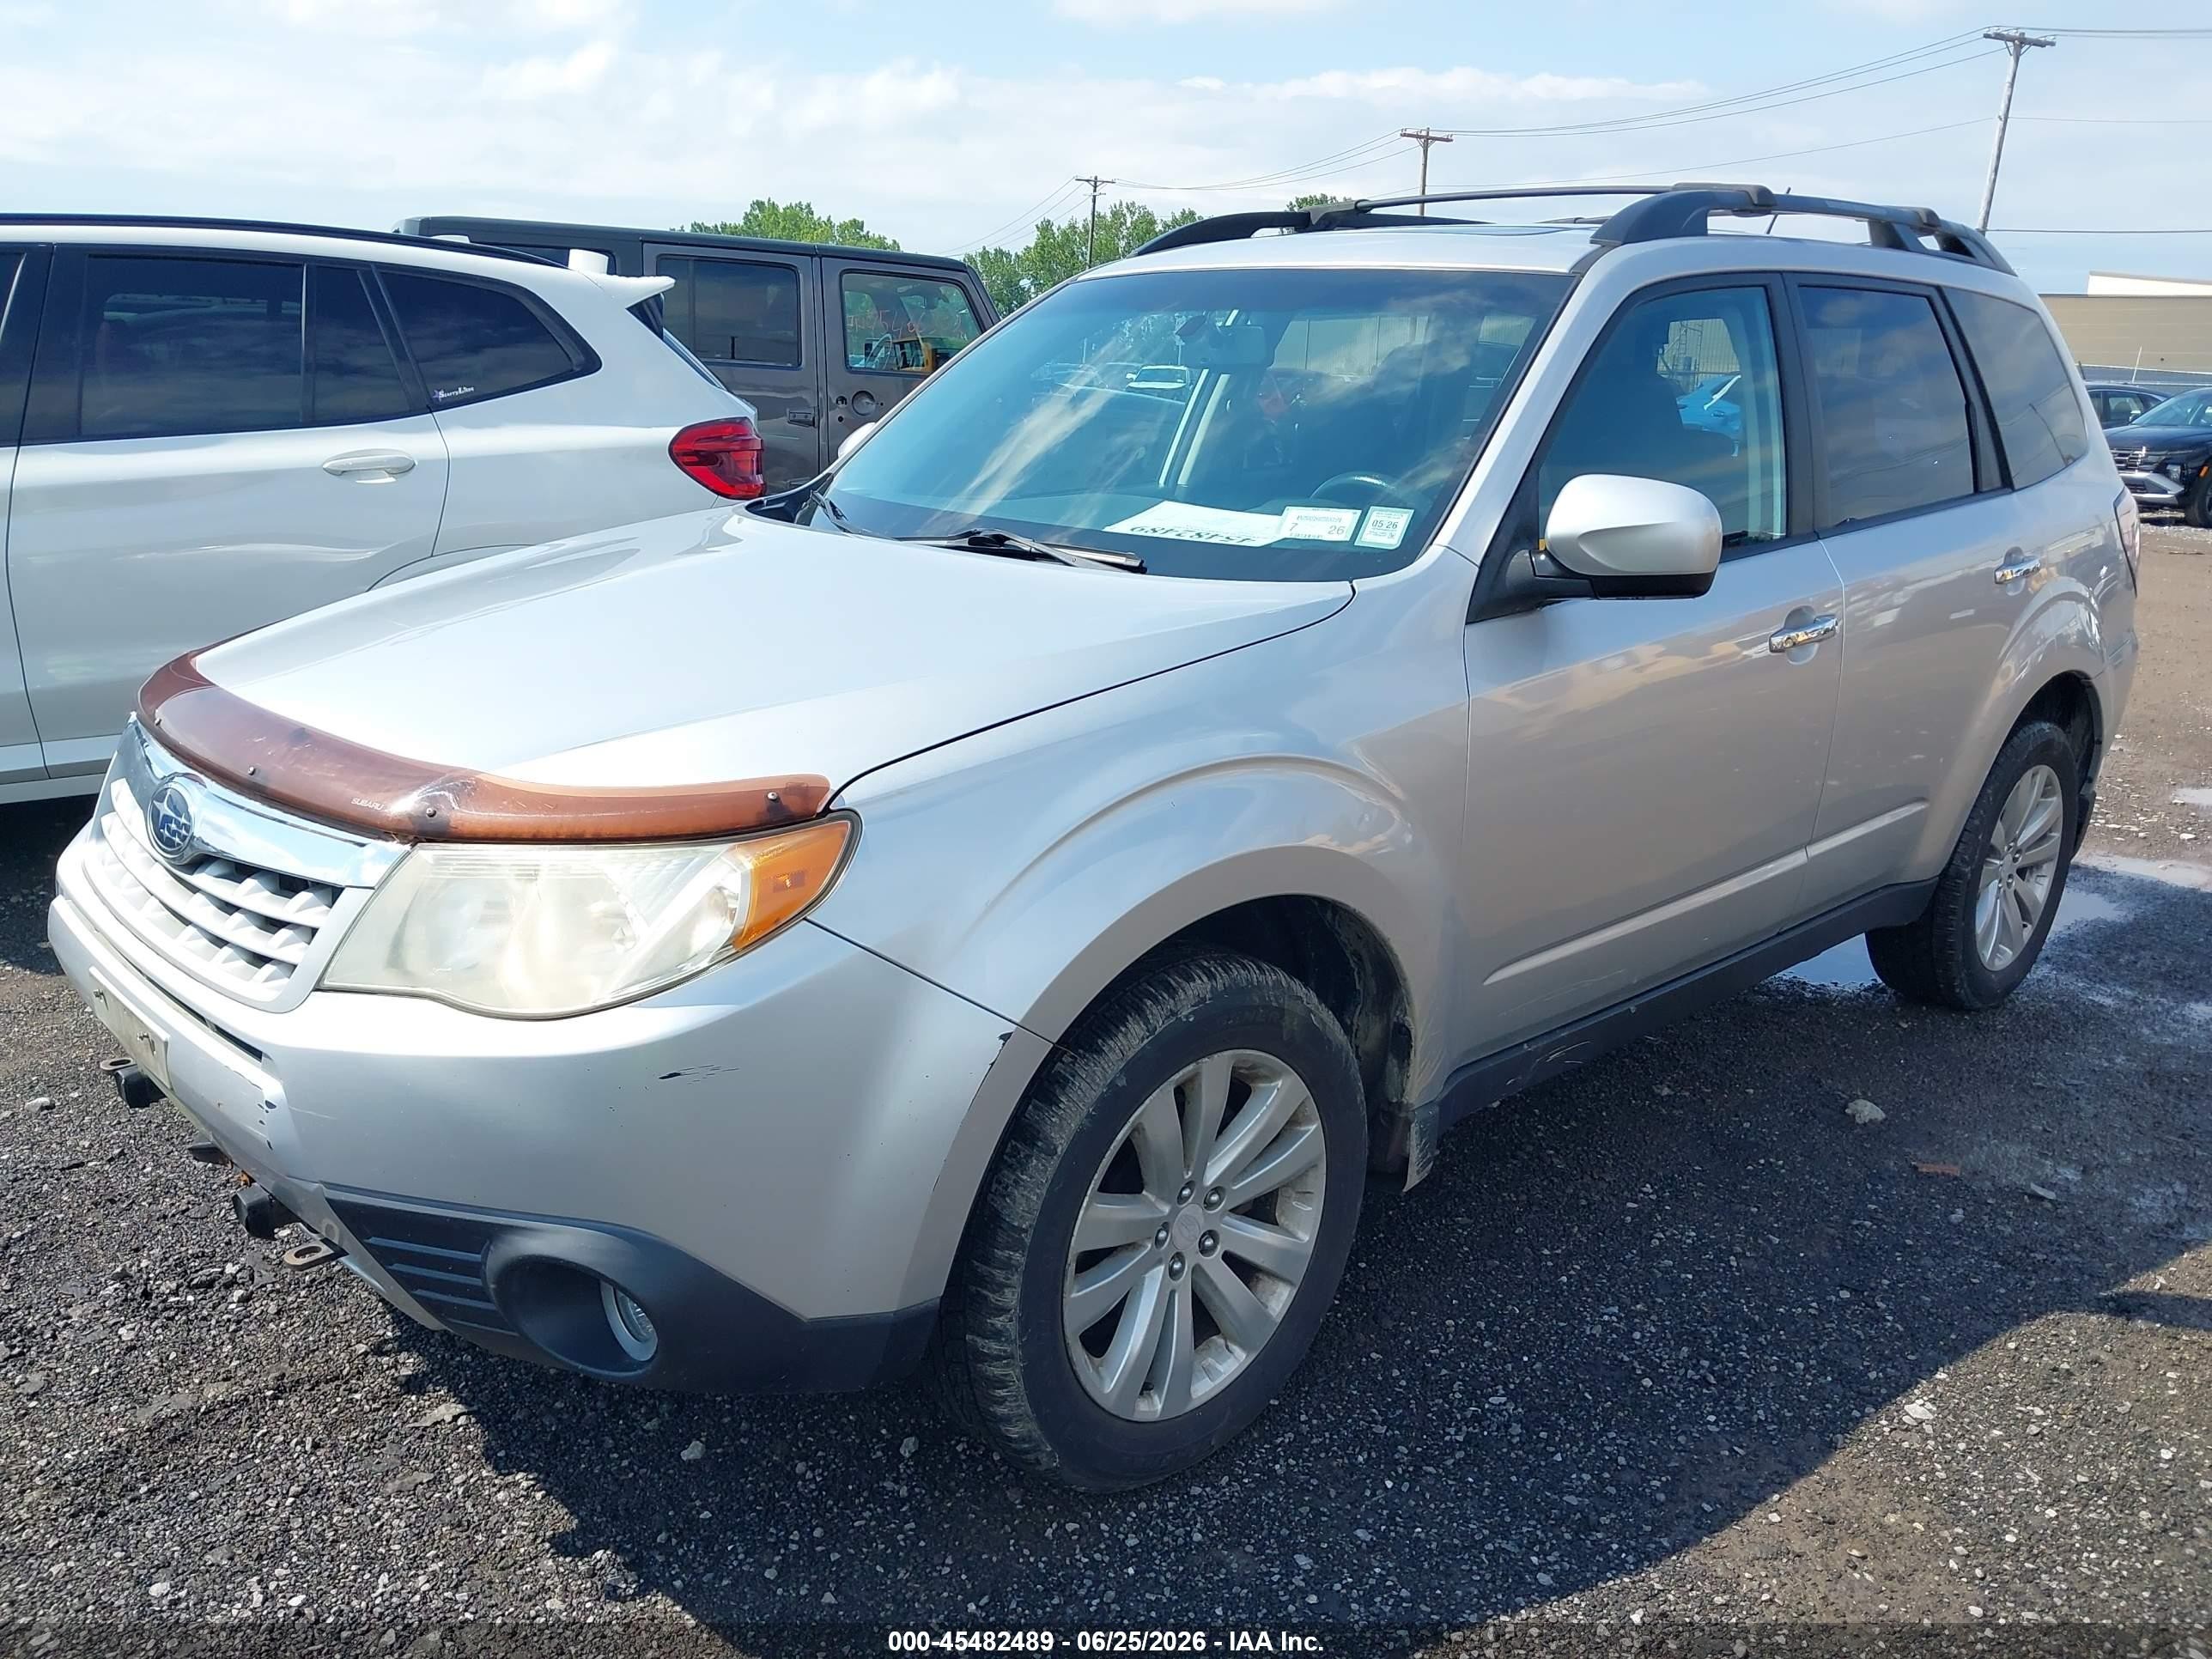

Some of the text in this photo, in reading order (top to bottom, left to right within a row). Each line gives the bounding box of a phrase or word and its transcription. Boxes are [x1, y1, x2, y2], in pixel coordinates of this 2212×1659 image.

[1290, 522, 1346, 535] 7 26
[1372, 519, 1399, 529] 05 26
[351, 798, 385, 811] SUBARU
